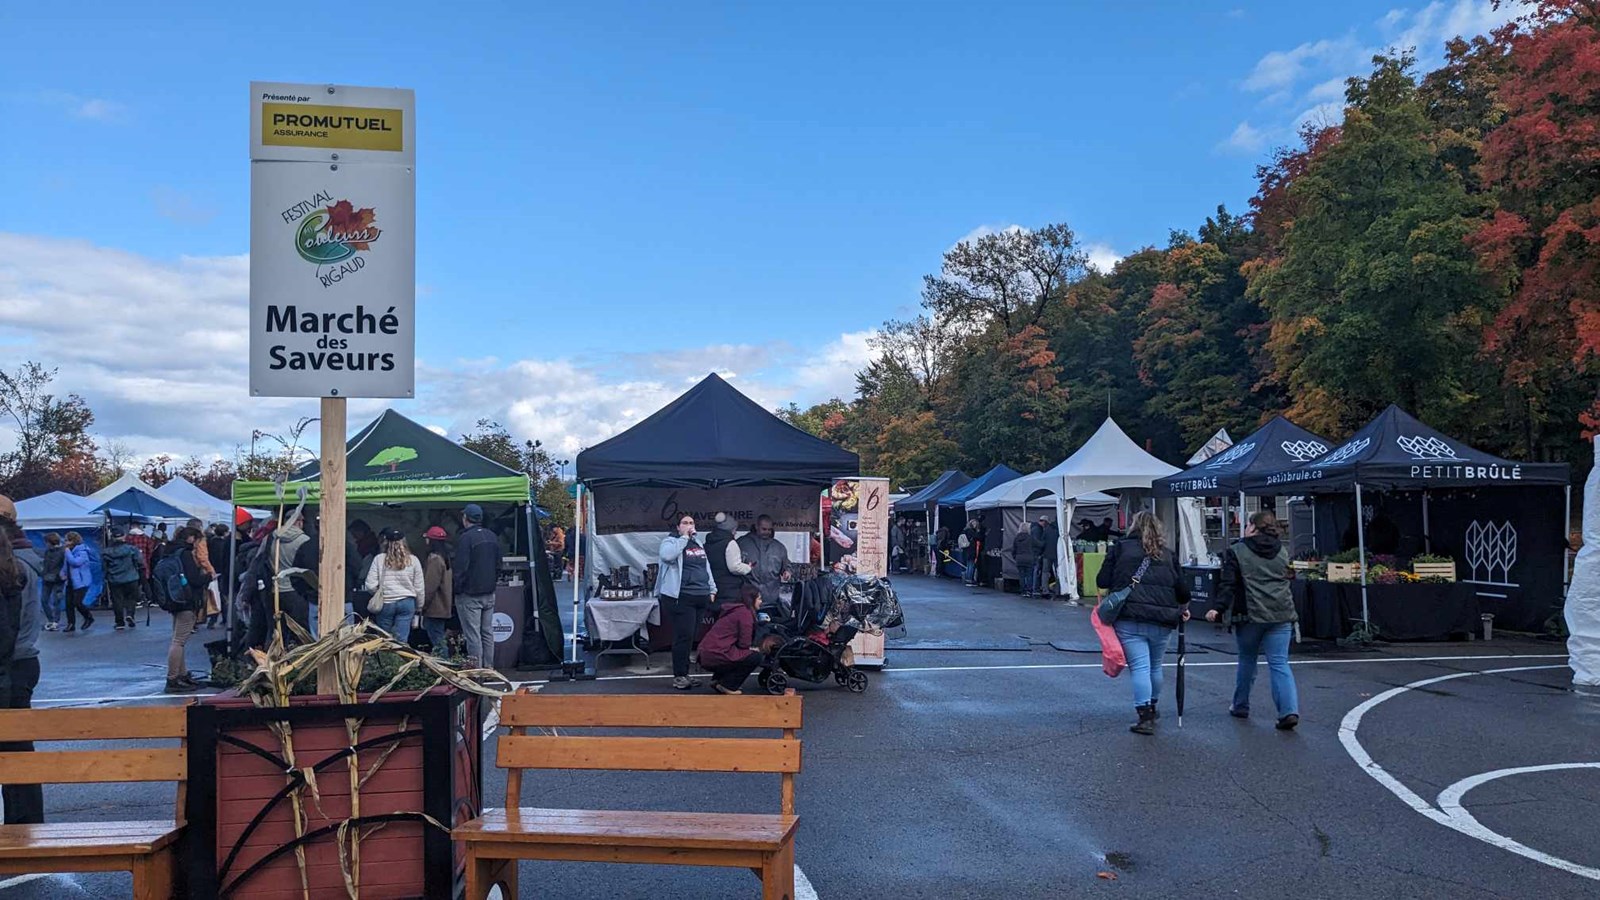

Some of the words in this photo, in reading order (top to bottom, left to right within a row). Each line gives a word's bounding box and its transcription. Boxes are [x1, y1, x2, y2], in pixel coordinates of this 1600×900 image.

[262, 93, 297, 102] Présenté
[273, 113, 392, 131] PROMUTUEL
[273, 129, 329, 138] ASSURANCE
[281, 189, 334, 224] FESTIVAL
[319, 256, 366, 289] RIGAUD
[265, 304, 399, 335] Marché
[316, 334, 348, 350] des
[269, 344, 395, 372] Saveurs
[1265, 469, 1322, 486] petitbrule.ca
[1410, 463, 1522, 480] PETITBRÛLÉ
[1169, 476, 1218, 492] PETITBRÛLÉ
